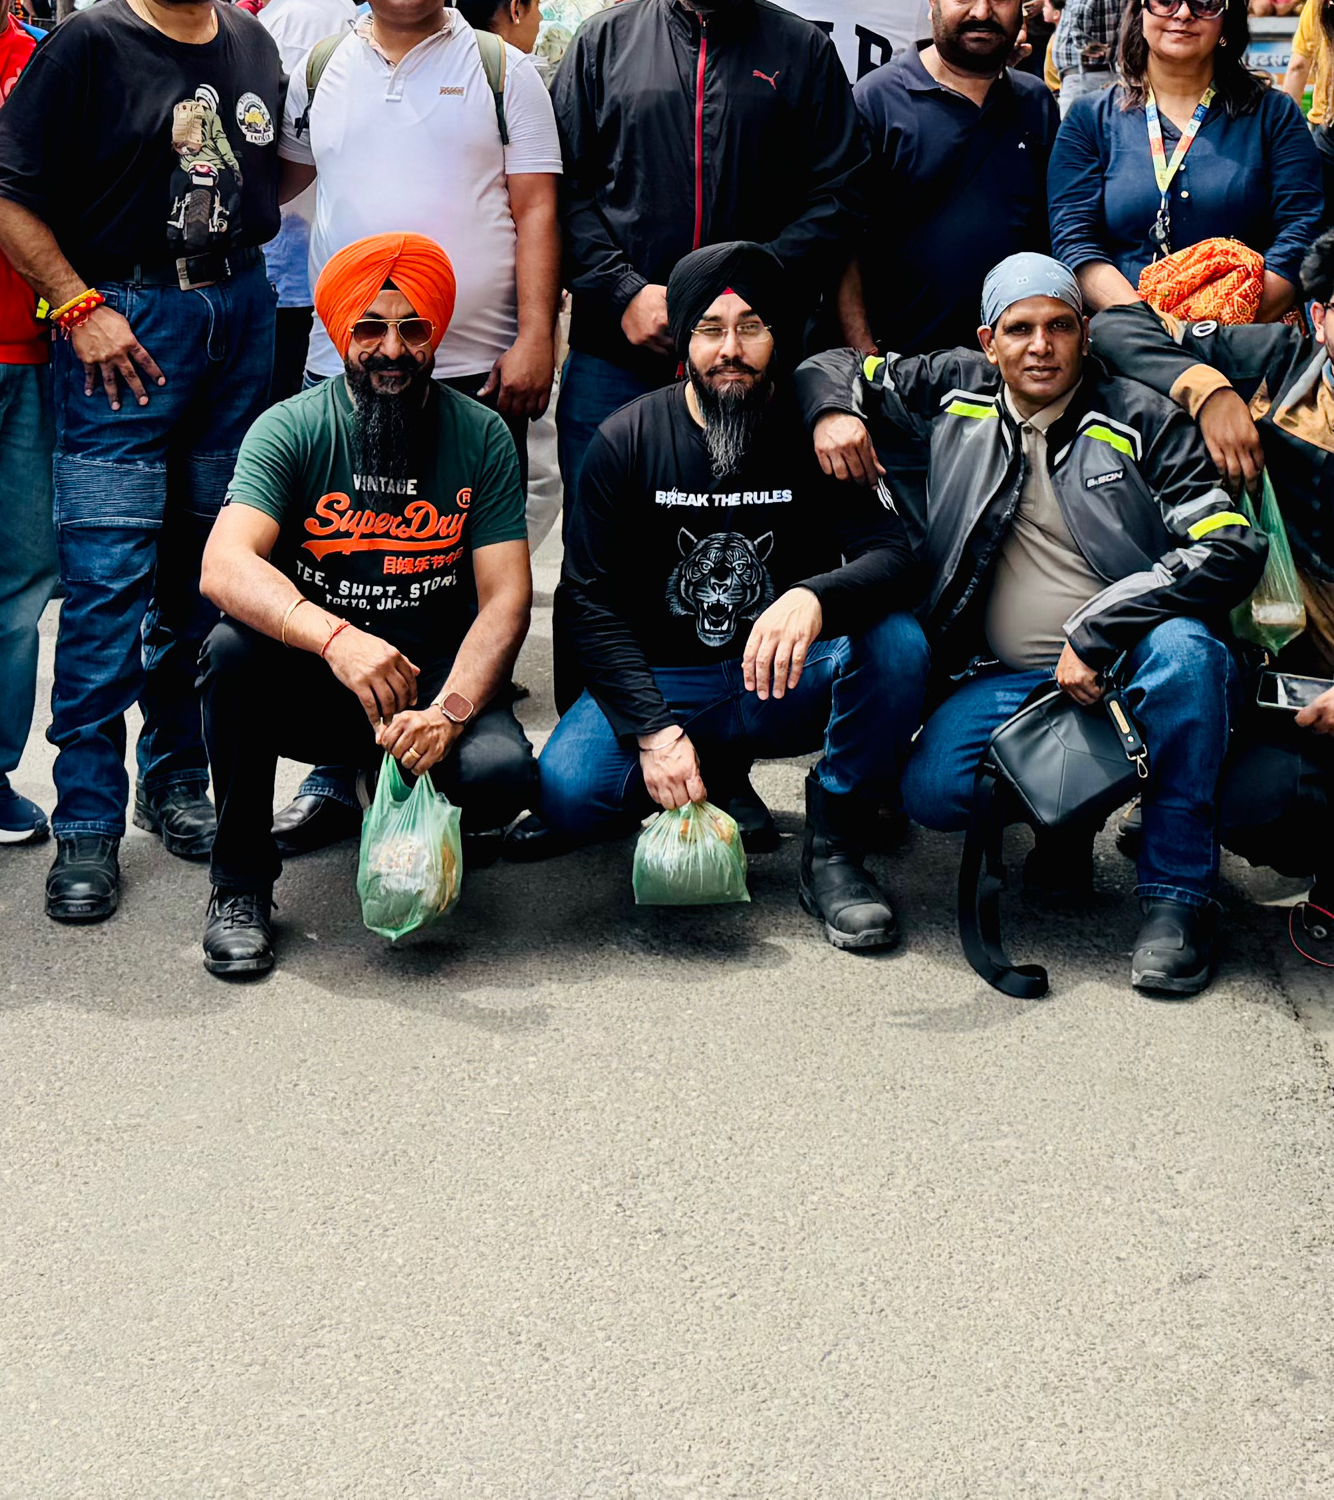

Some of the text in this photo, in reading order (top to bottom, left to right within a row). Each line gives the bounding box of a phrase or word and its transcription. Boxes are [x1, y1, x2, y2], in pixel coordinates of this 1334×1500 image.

[352, 473, 417, 495] VINTAGE
[655, 487, 793, 508] BREAK THE RULES
